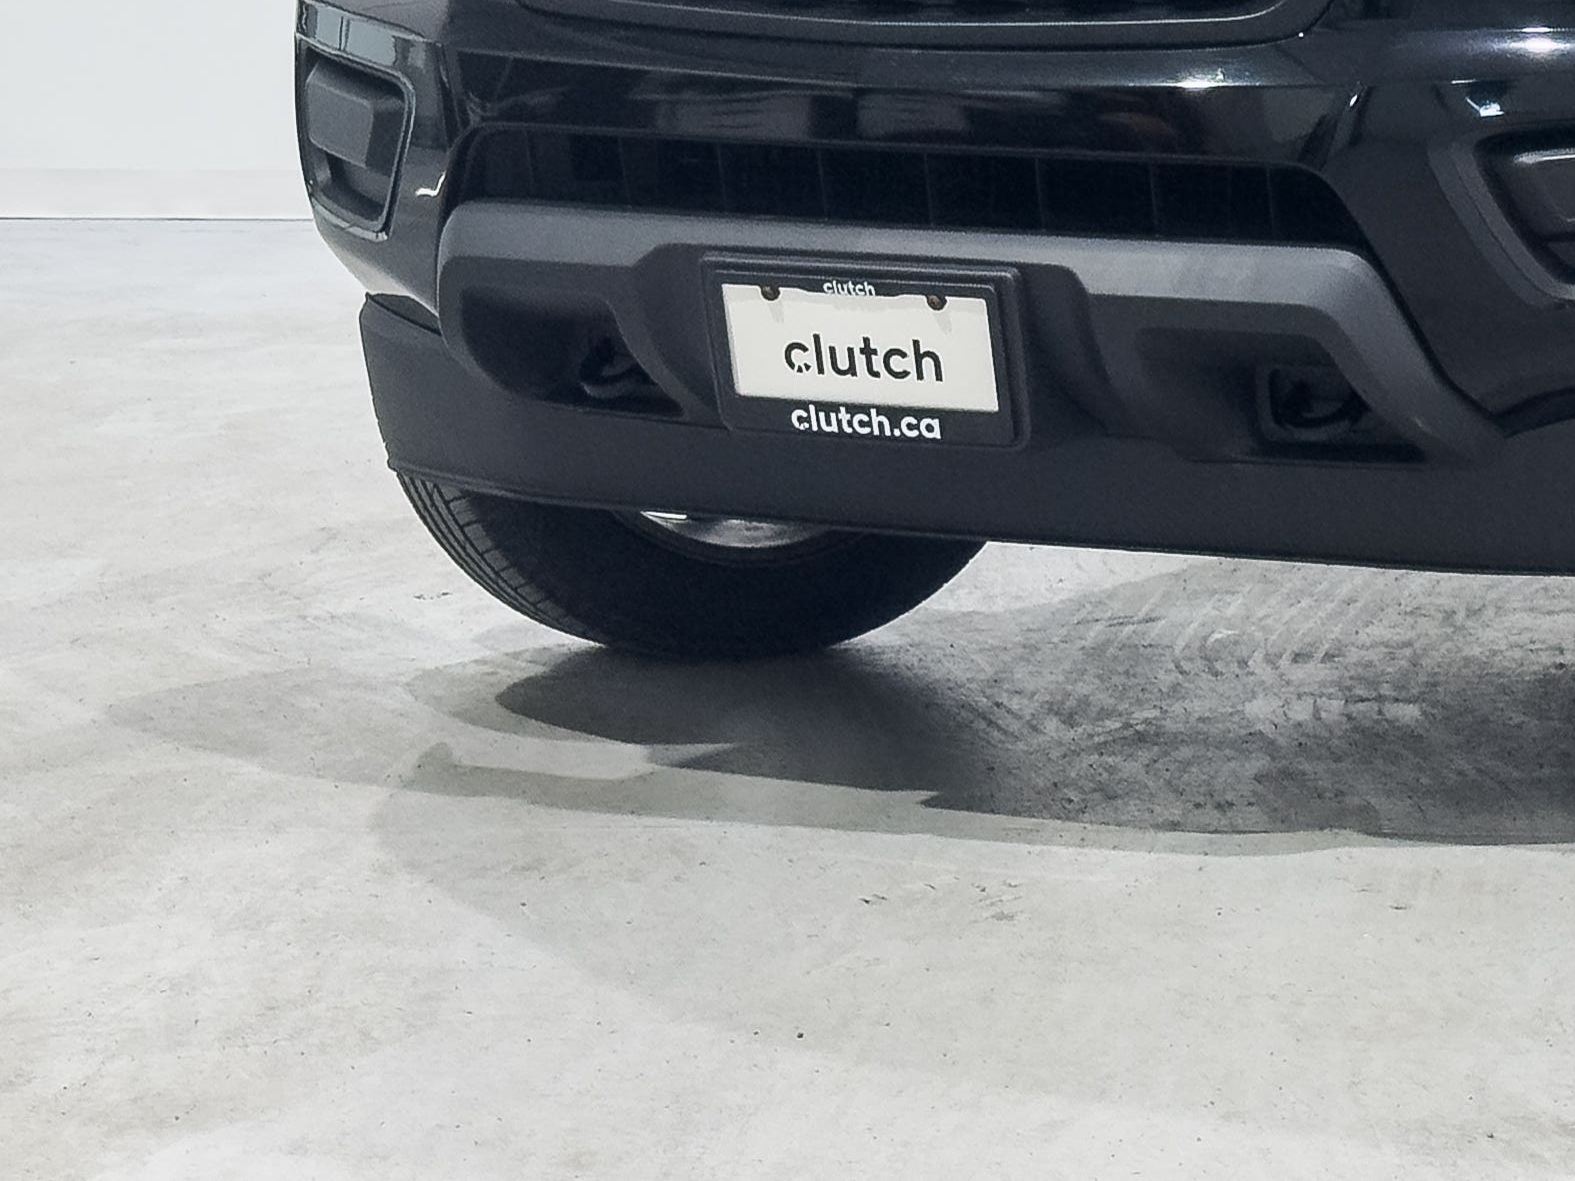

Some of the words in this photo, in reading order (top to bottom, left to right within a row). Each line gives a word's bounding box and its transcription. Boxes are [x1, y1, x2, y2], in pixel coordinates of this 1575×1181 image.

[823, 280, 876, 296] clutch
[784, 333, 944, 382] clutch
[790, 404, 942, 439] clutch.ca
